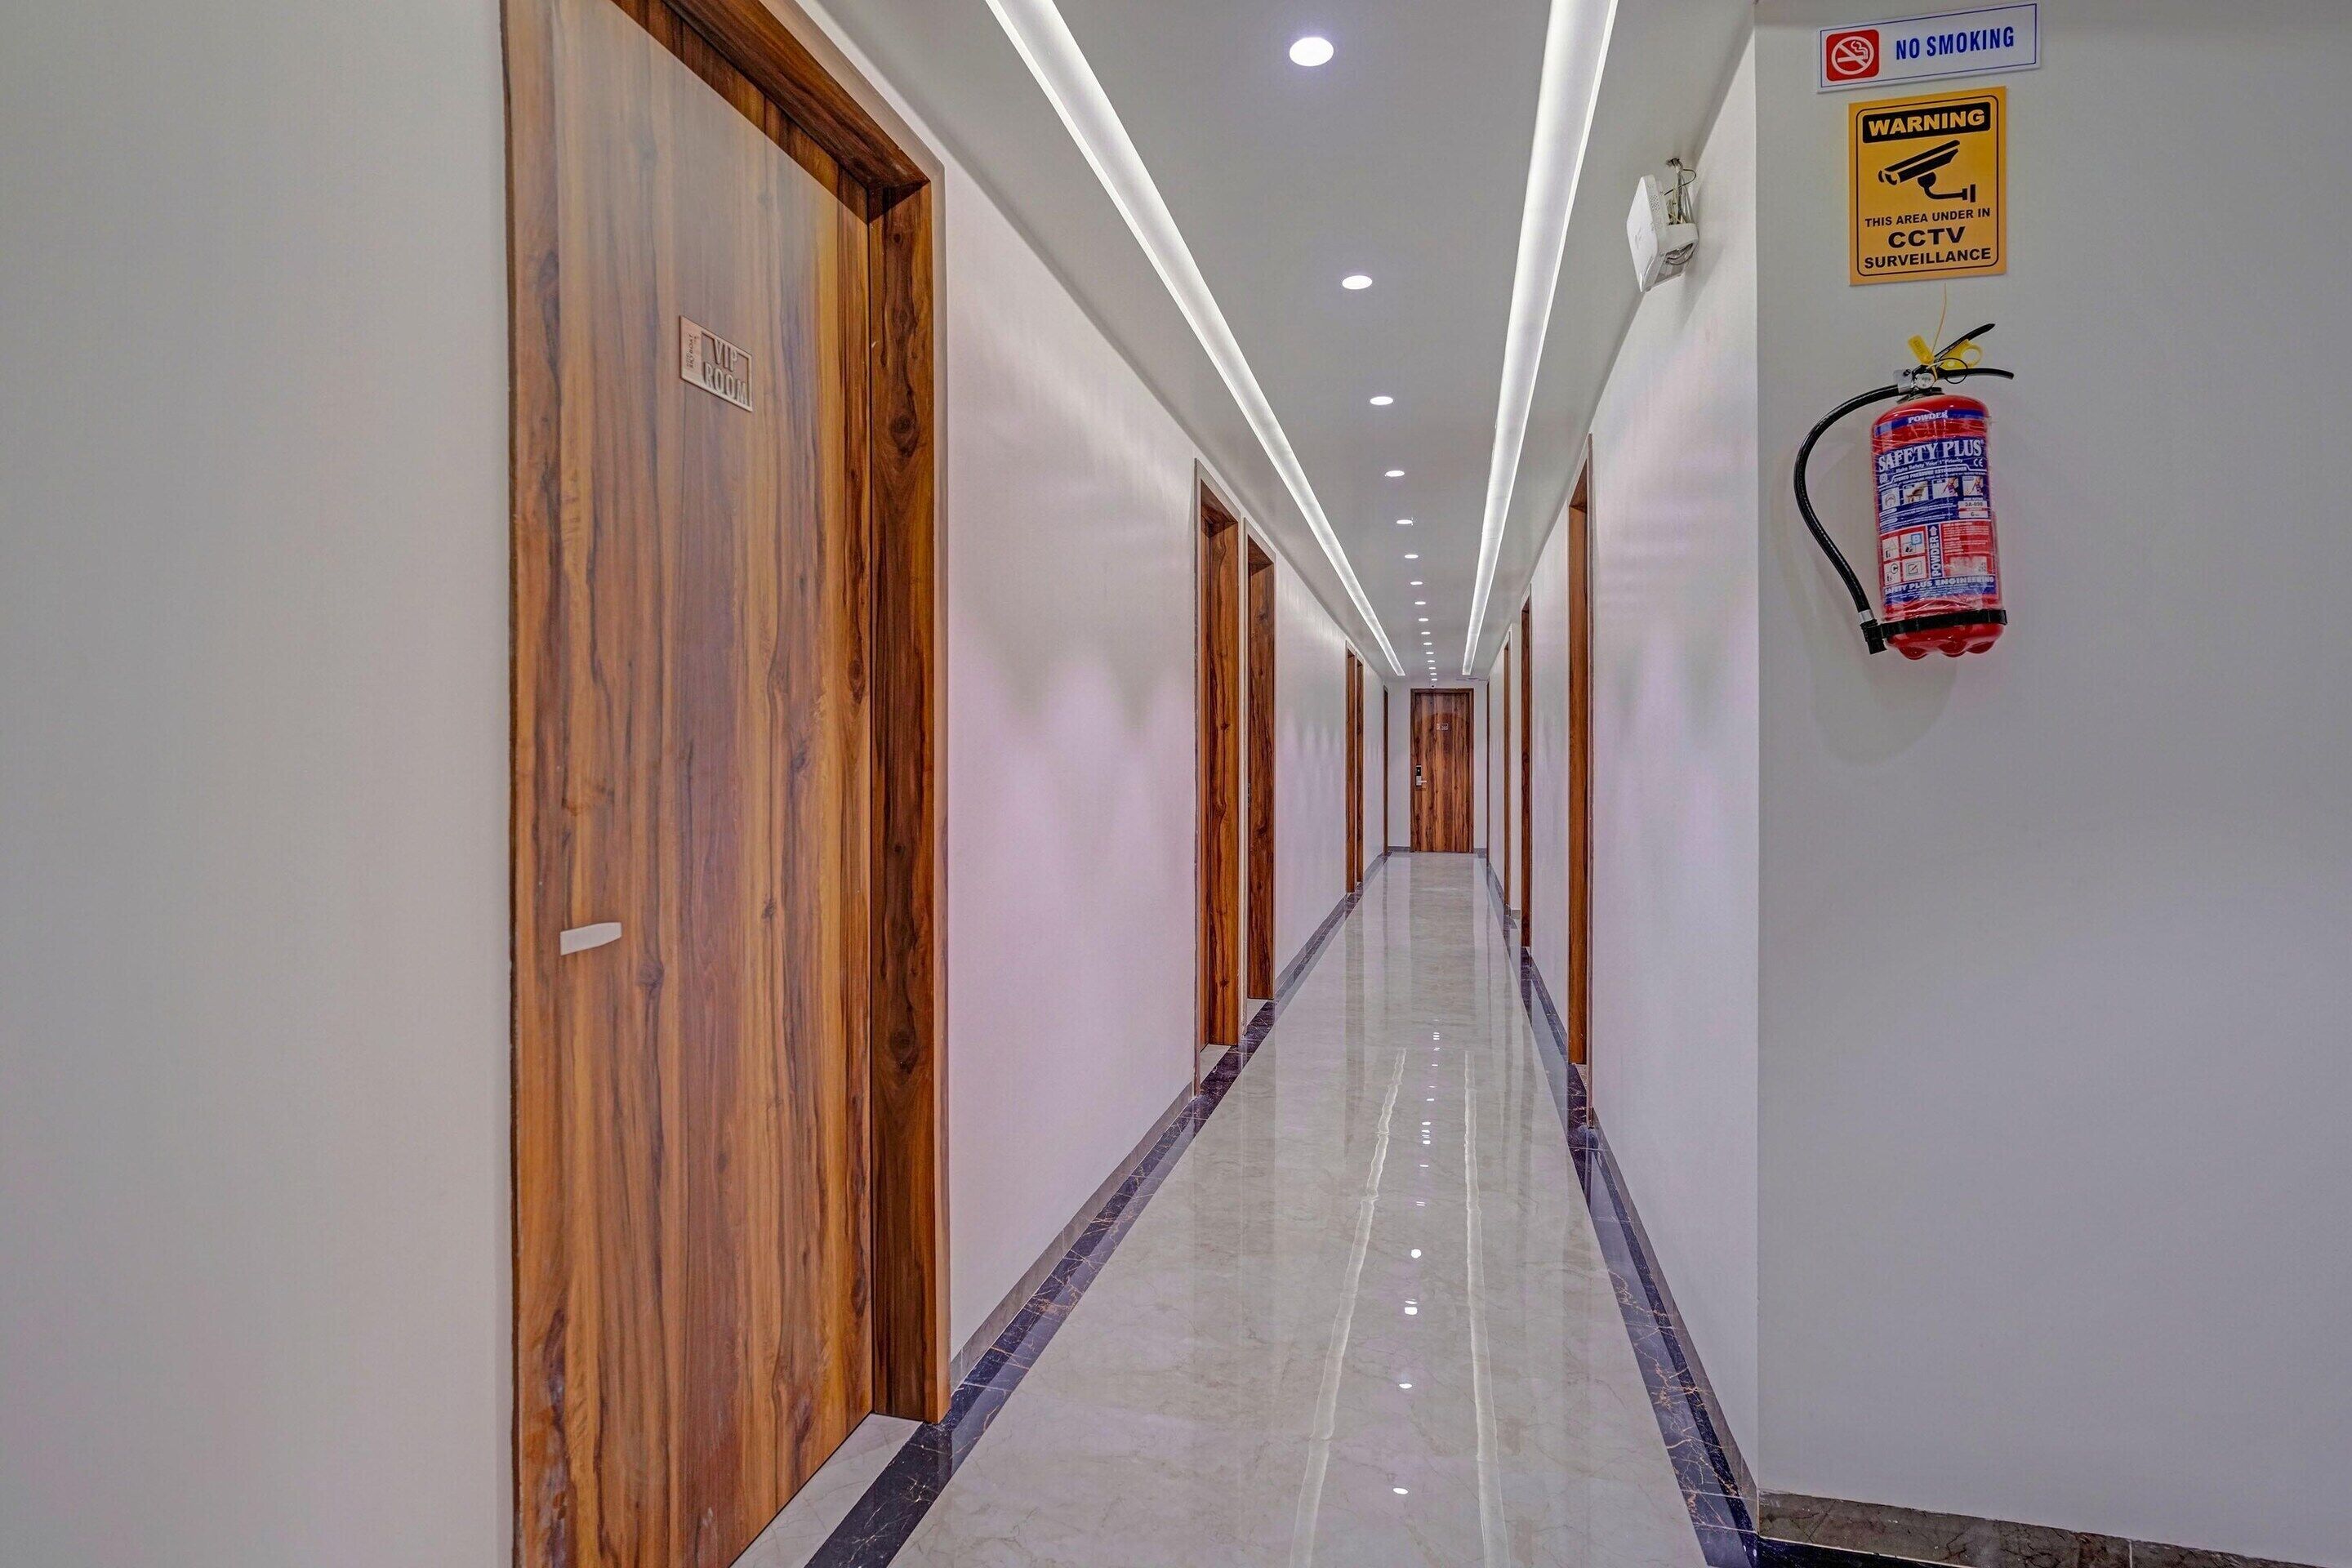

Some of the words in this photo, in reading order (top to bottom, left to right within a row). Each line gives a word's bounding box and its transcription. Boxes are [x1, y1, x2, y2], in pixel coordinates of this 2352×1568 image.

[1895, 38, 1920, 60] NO
[1927, 26, 2014, 56] SMOKING
[1869, 109, 1984, 136] WARNING
[1864, 216, 1892, 227] THIS
[1896, 213, 1928, 225] AREA
[1932, 209, 1974, 221] UNDER
[1978, 207, 1990, 217] IN
[1888, 226, 1966, 248] CCTV
[1864, 247, 1991, 269] SURVEILLANCE
[713, 338, 738, 372] VIP
[703, 361, 747, 405] ROOM
[1908, 410, 1949, 424] POWDER
[1878, 442, 1939, 473] SAFETY
[1942, 439, 1982, 458] PLUS
[1930, 536, 1941, 577] POWDER
[1909, 580, 1932, 589] PLUS
